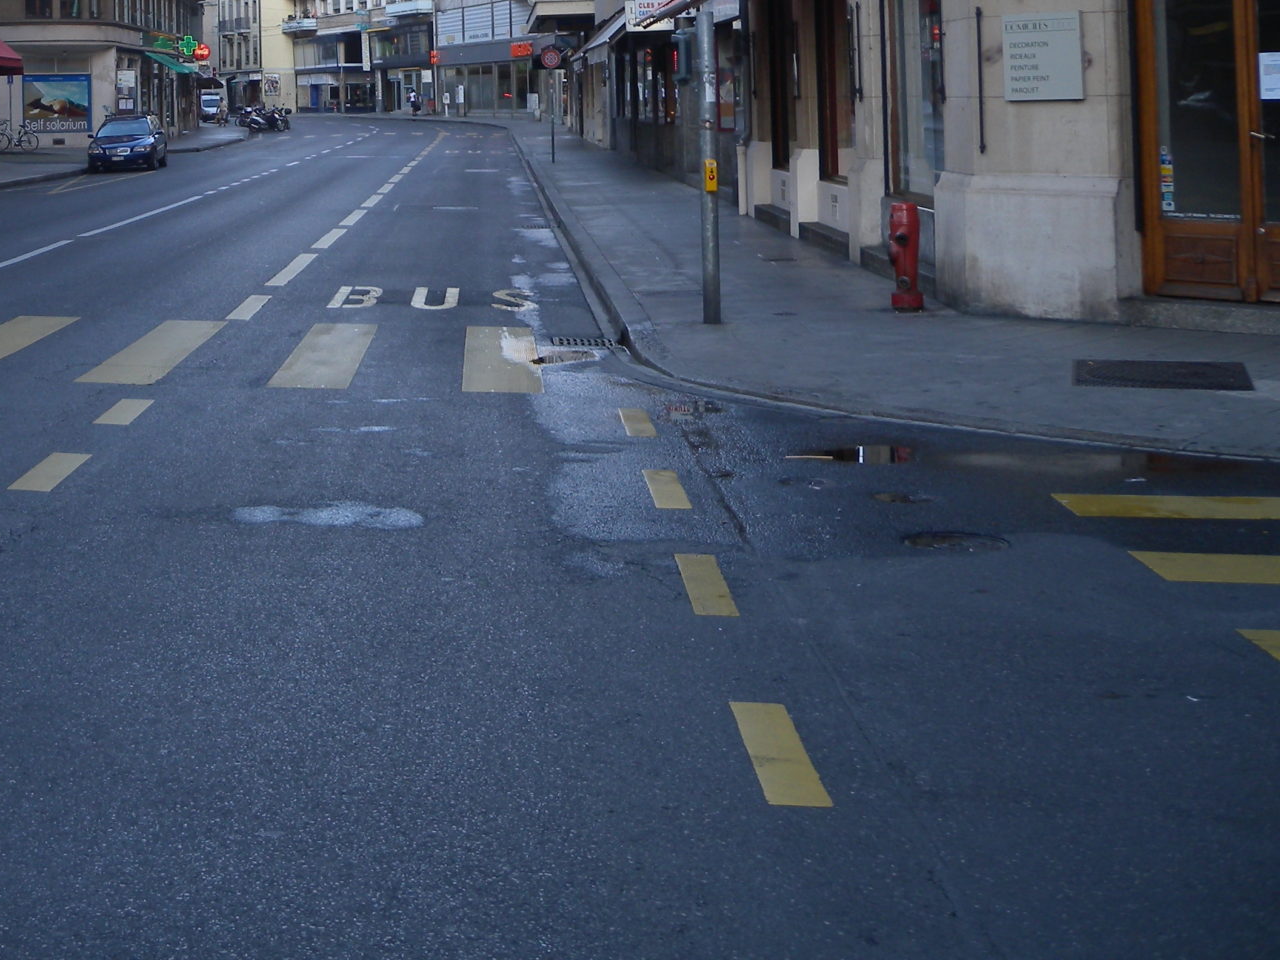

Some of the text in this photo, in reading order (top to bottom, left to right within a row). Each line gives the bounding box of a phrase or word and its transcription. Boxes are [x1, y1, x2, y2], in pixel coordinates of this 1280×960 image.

[1009, 40, 1049, 49] DECORATION
[24, 118, 88, 131] Self solarium
[326, 286, 539, 311] BUS
